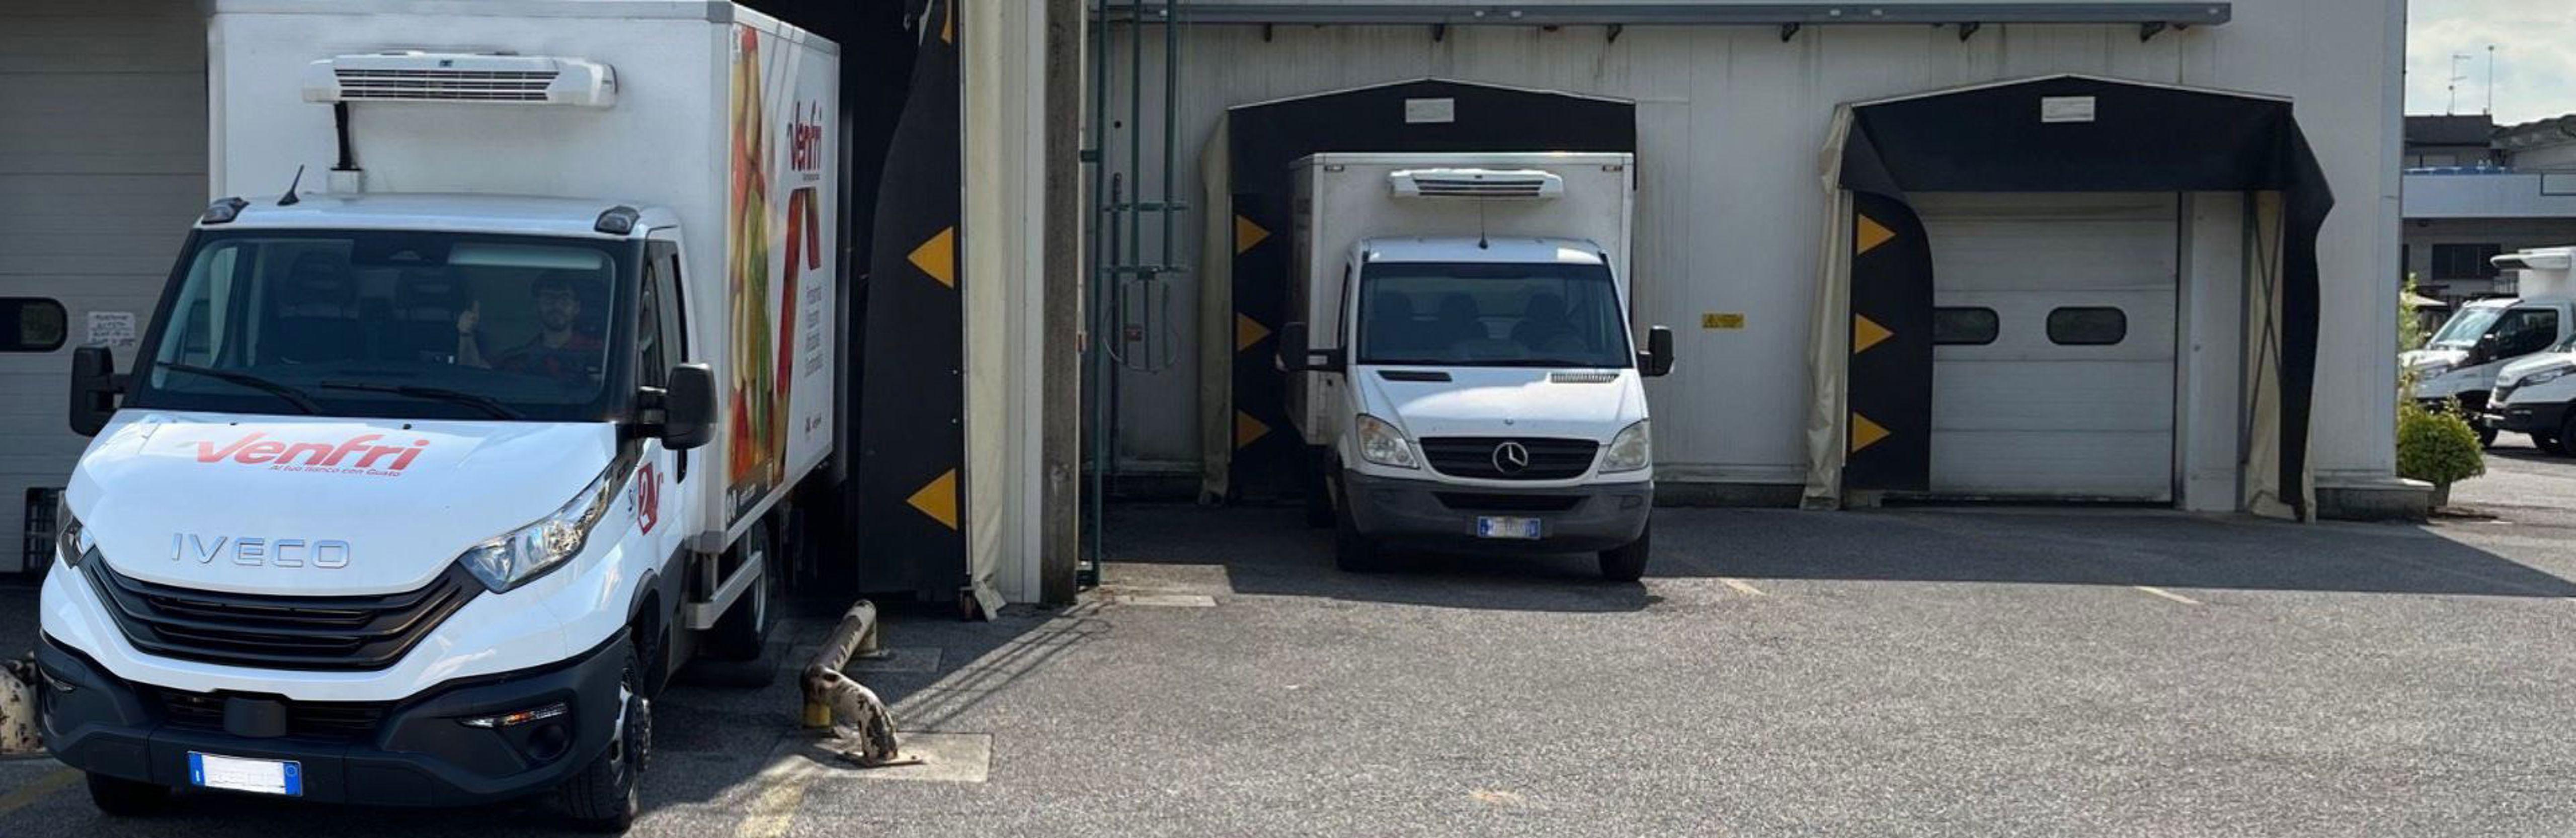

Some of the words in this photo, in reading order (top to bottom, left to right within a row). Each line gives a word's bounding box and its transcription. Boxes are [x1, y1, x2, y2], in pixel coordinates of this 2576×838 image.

[197, 431, 430, 470] Venfri
[366, 469, 400, 477] Gusto
[172, 533, 350, 569] IVECO
